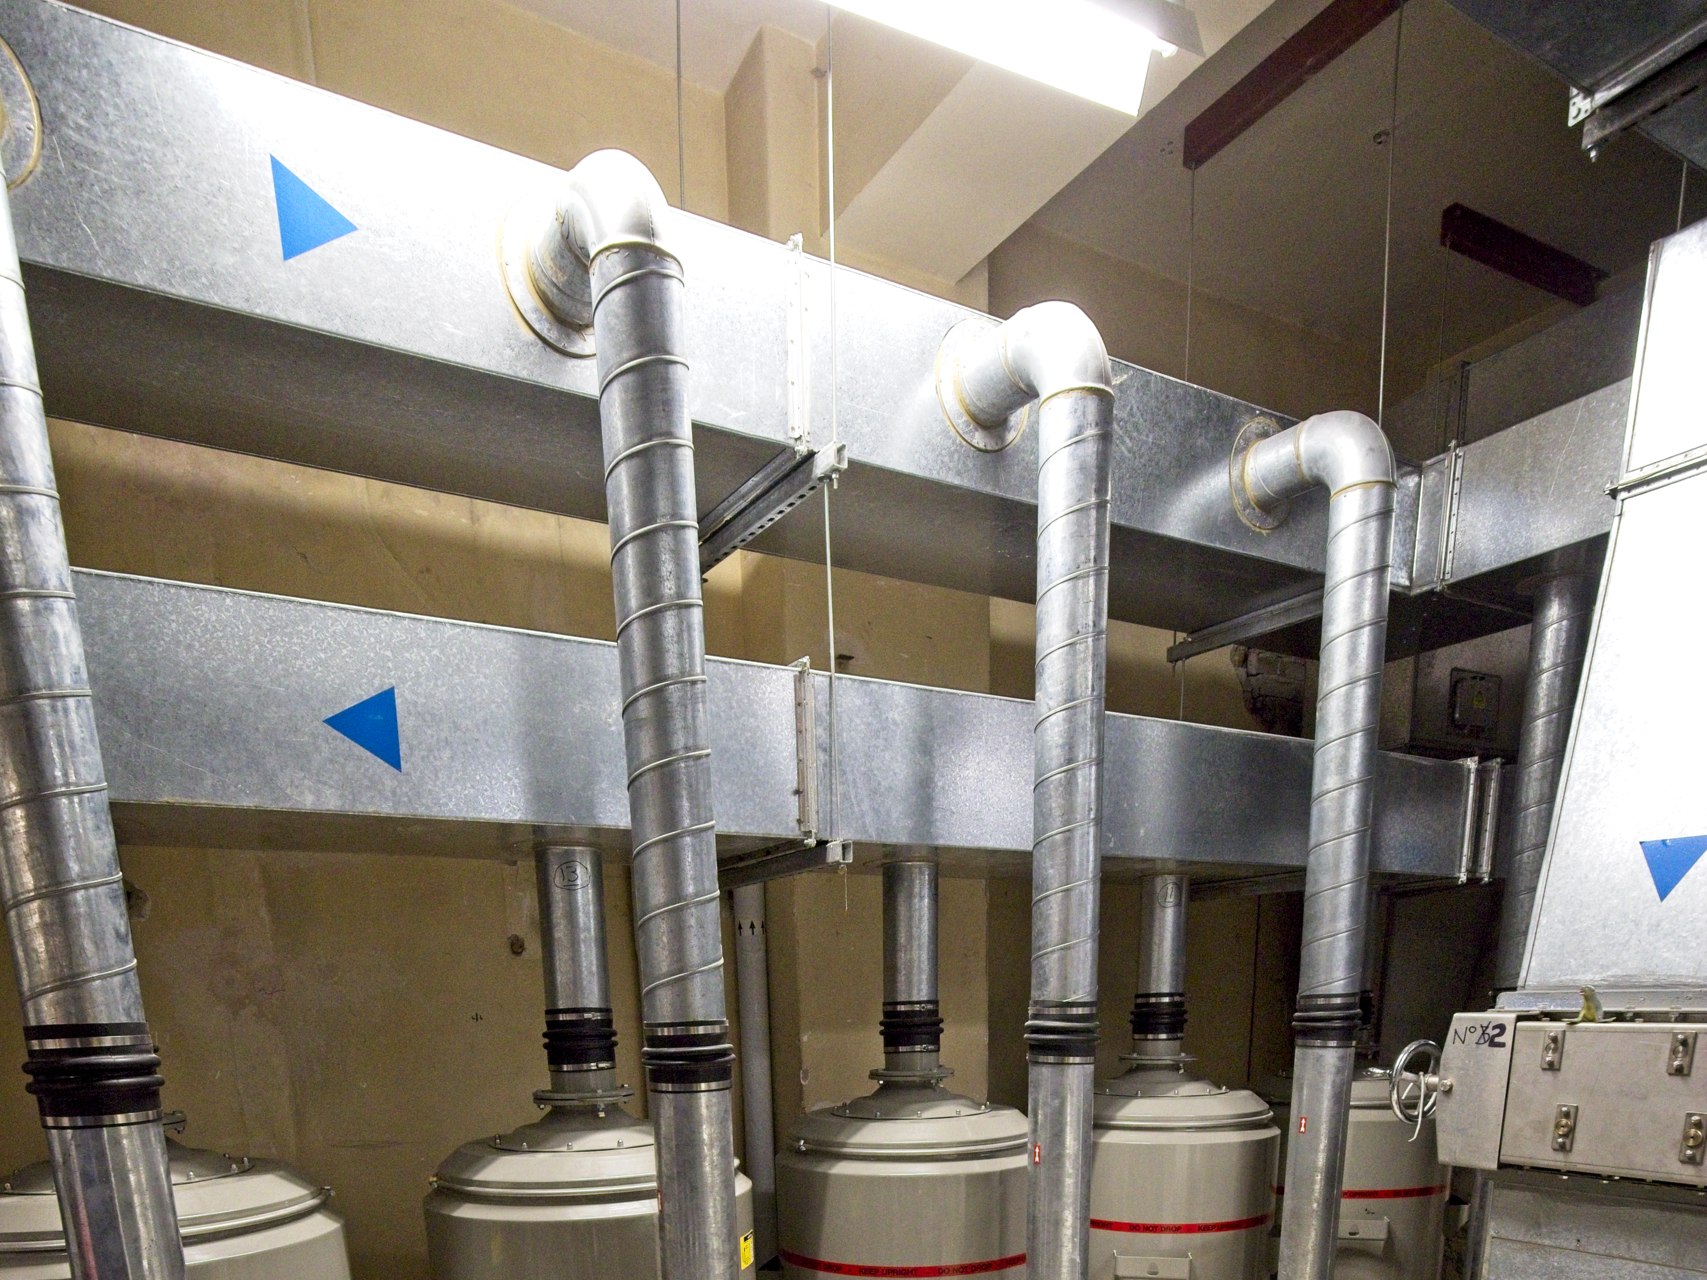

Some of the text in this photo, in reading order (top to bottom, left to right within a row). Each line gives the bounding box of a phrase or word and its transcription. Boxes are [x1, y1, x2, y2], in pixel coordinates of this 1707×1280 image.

[560, 865, 579, 883] 13
[1160, 1225, 1182, 1233] DROP
[1198, 1224, 1216, 1232] KEEP
[881, 1268, 918, 1276] UPRIGHT
[937, 1267, 951, 1275] DO
[952, 1265, 969, 1274] NOT
[970, 1262, 992, 1272] DROP
